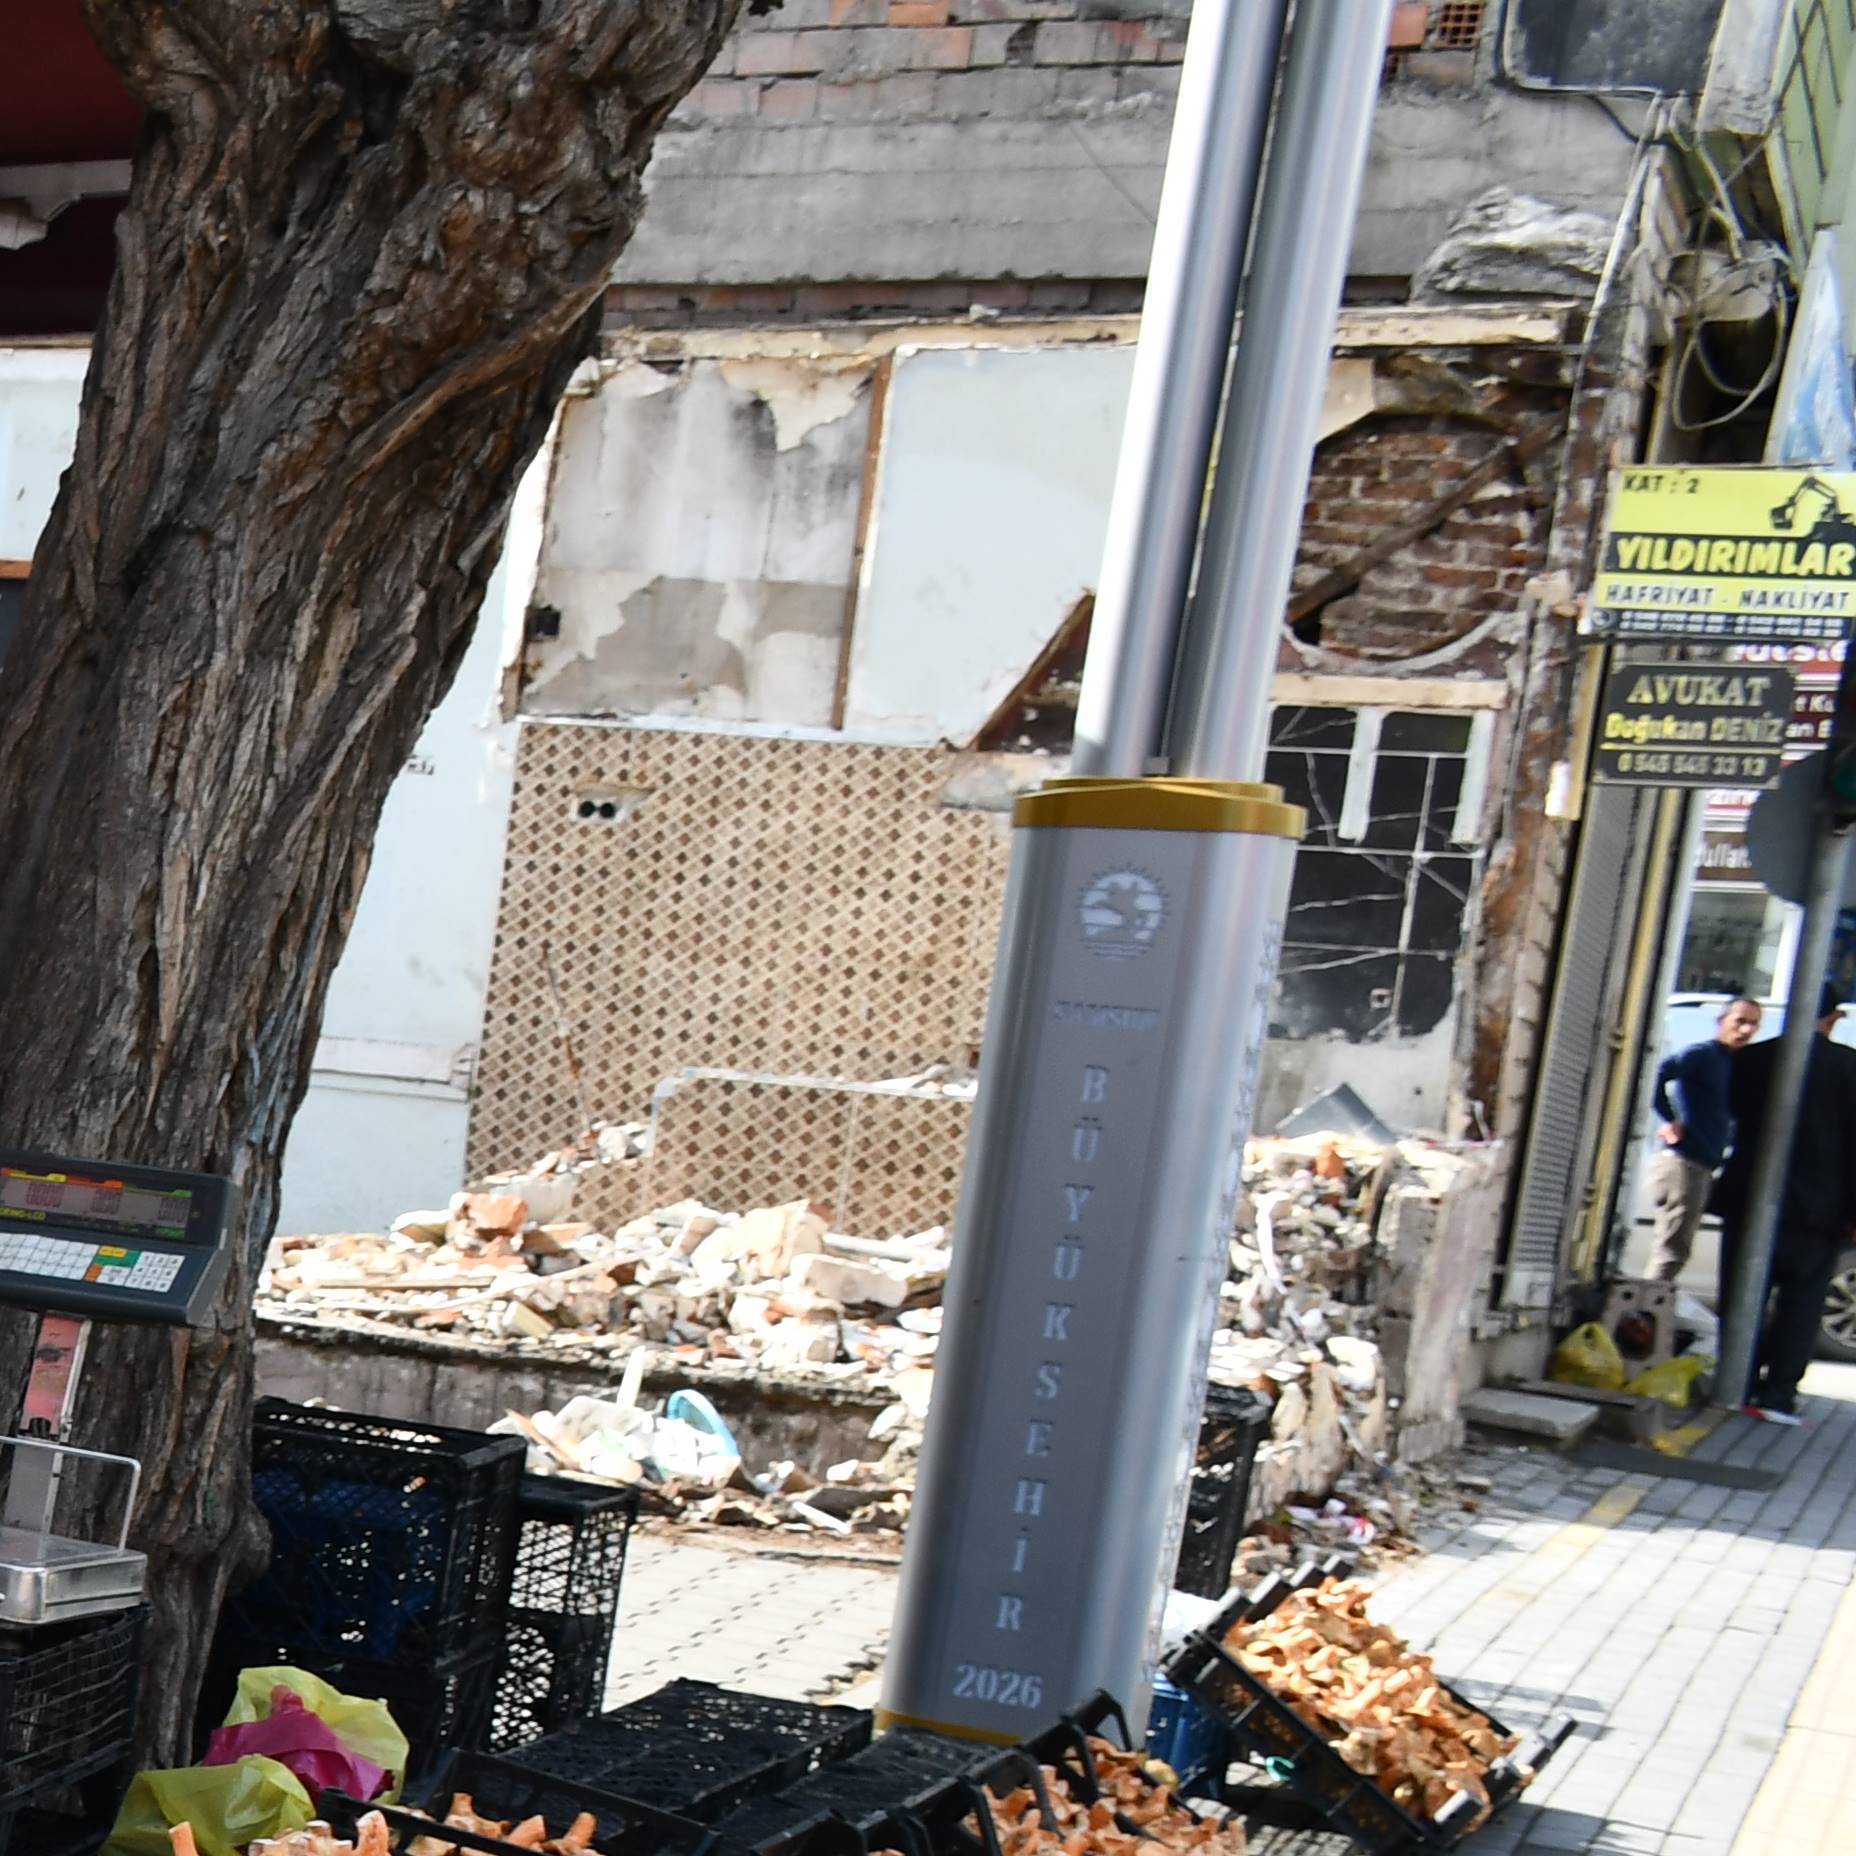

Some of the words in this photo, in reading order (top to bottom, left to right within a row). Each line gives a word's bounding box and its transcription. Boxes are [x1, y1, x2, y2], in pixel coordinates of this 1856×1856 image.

[1624, 475, 1663, 493] KAT
[1687, 479, 1699, 495] 2
[1617, 536, 1855, 577] YILDIRIMLAR
[1606, 584, 1714, 607] HAFRİYAT
[1739, 590, 1849, 611] NAKLİYAT
[1626, 674, 1771, 706] AVUKAT
[1604, 713, 1707, 744] Doğukan
[1709, 711, 1786, 742] DENİZ
[952, 1663, 1042, 1709] 2026
